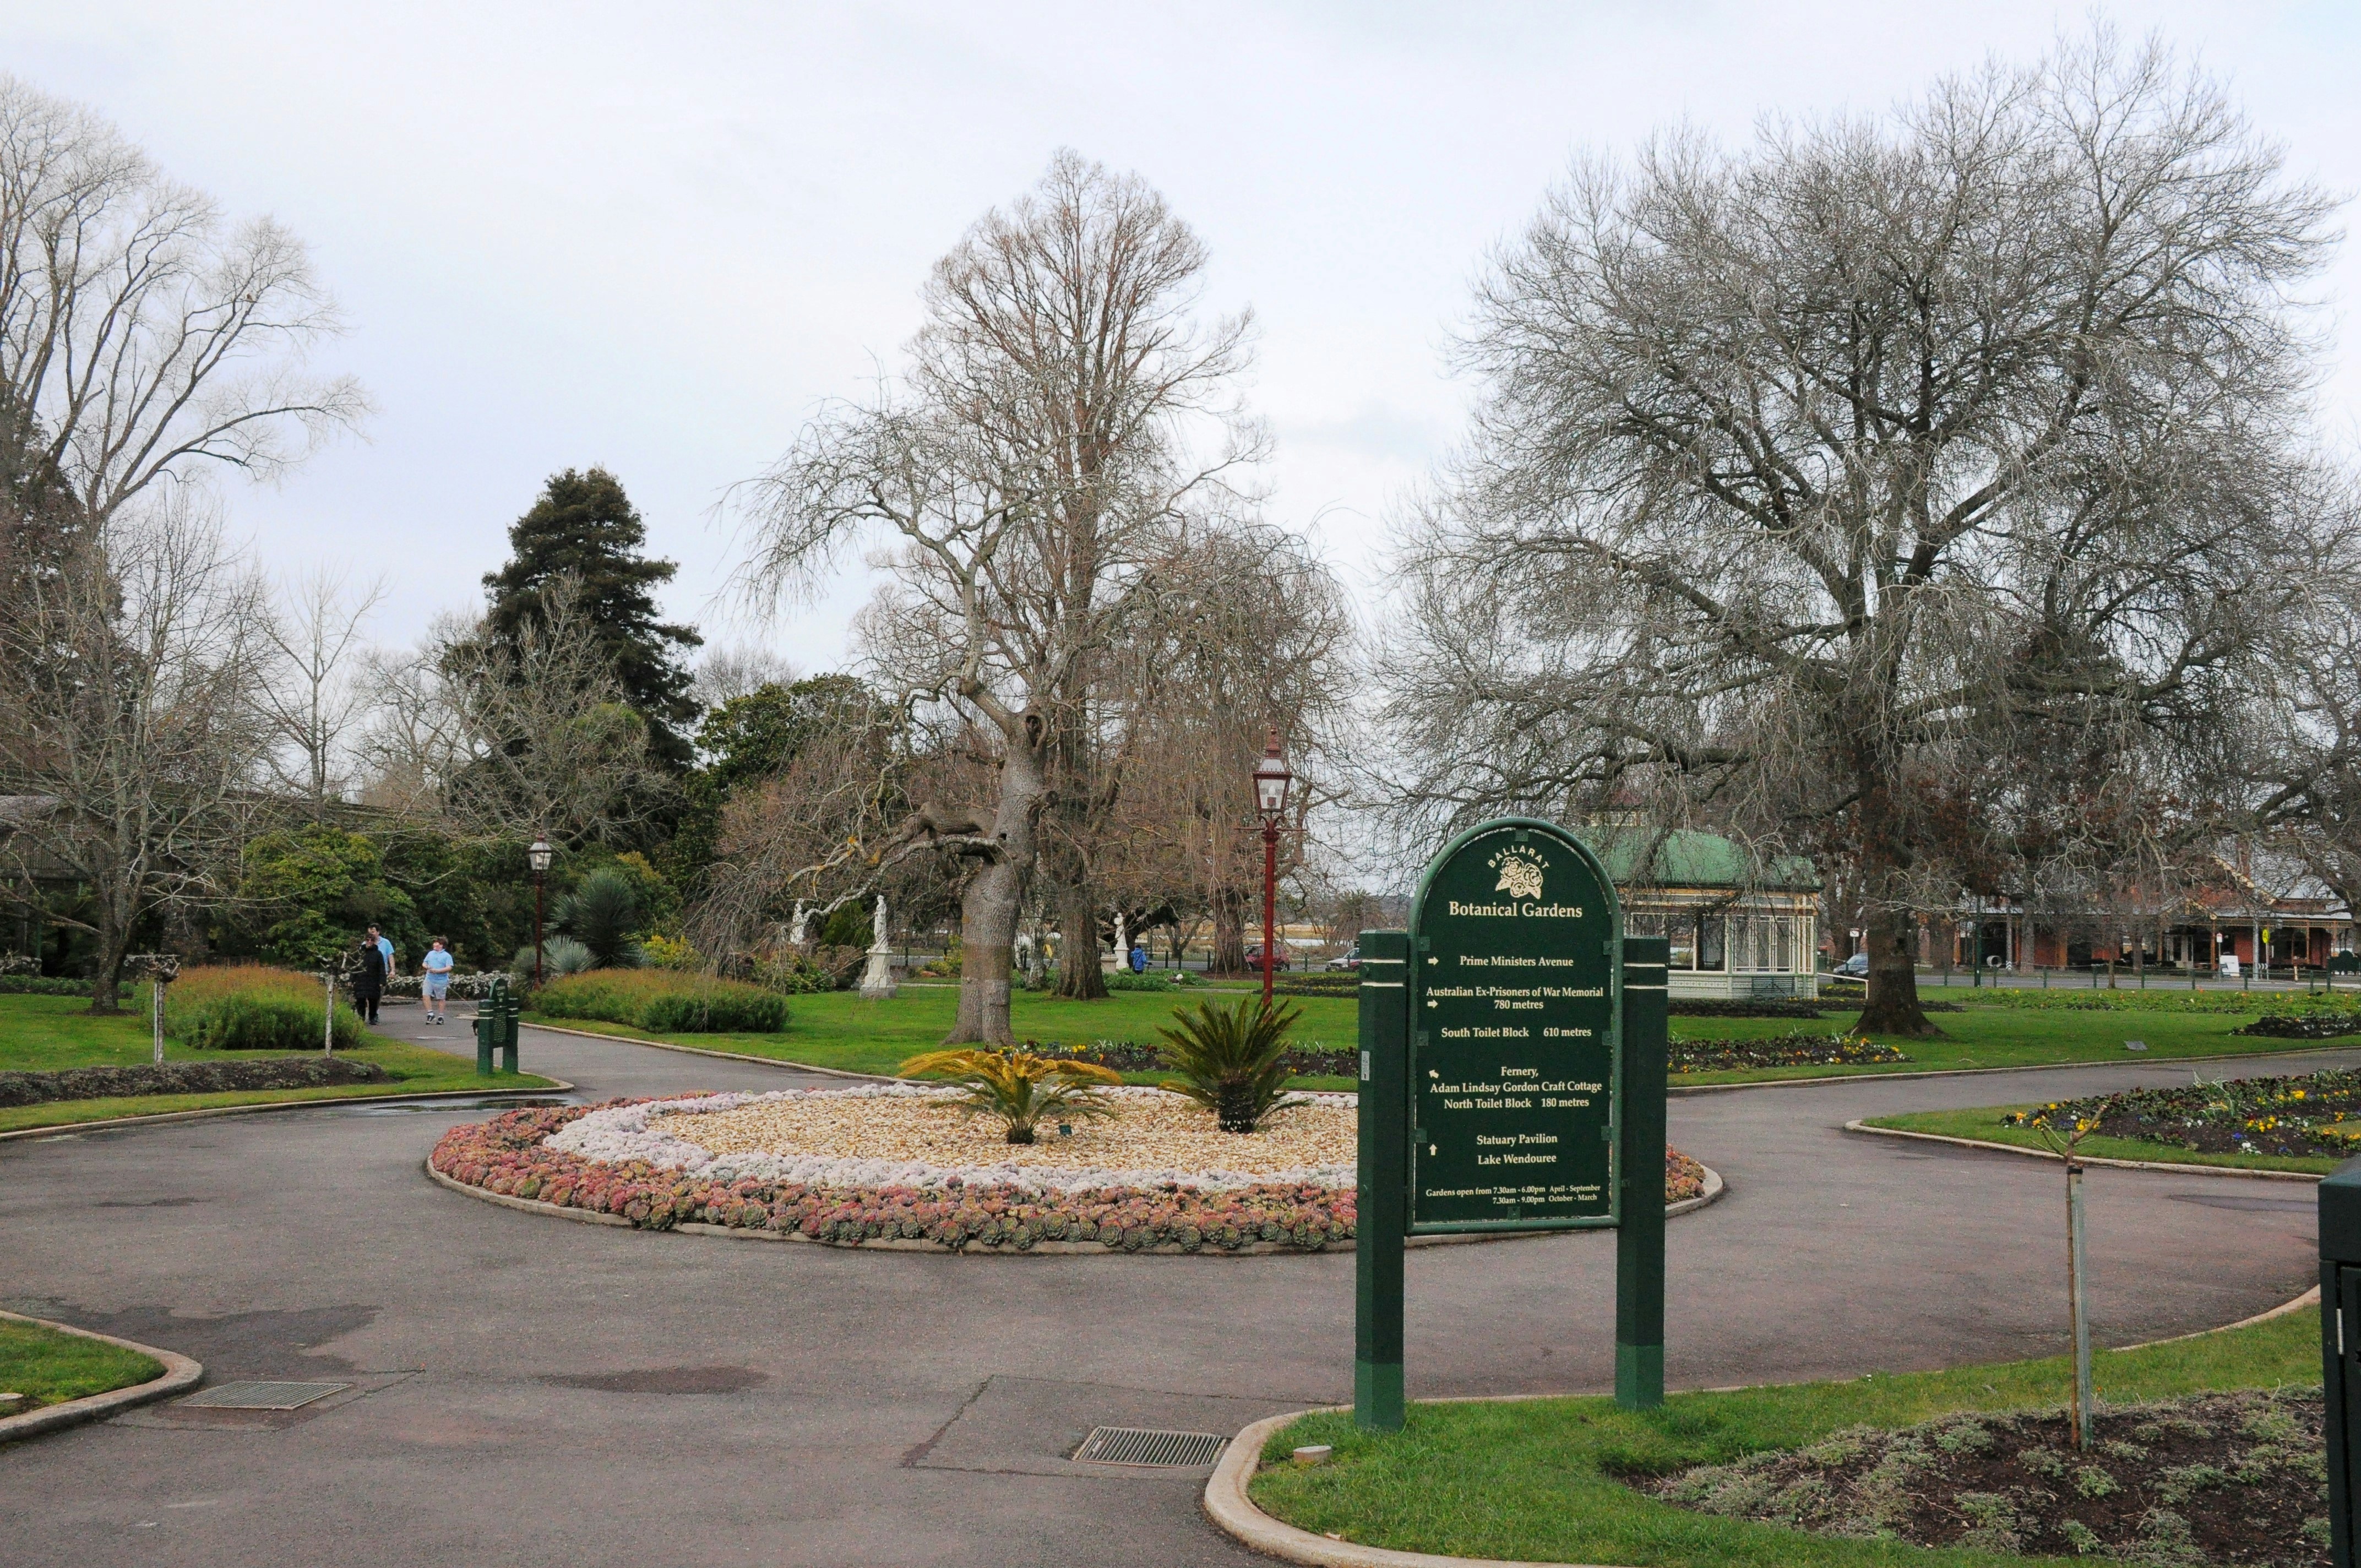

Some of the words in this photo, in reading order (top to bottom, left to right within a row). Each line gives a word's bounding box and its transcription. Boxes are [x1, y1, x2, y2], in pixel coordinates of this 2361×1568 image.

[1487, 845, 1551, 869] BALLARAT
[1449, 901, 1518, 917] Botanical
[1522, 902, 1582, 918] Gardens
[1460, 955, 1489, 966] Prime
[1491, 956, 1536, 966] Ministers
[1538, 956, 1574, 967] Avenue
[1426, 986, 1474, 997] Australian
[1475, 986, 1530, 997] Ex-Prisoners
[1531, 986, 1542, 997] of
[1543, 987, 1561, 997] War
[1562, 987, 1603, 997] Memorial
[1494, 999, 1510, 1009] 780
[1512, 1000, 1544, 1009] metres
[1441, 1027, 1471, 1038] South
[1472, 1027, 1500, 1037] Toilet
[1502, 1027, 1530, 1037] Block
[1543, 1027, 1559, 1037] 610
[1560, 1027, 1592, 1037] metres
[1500, 1066, 1539, 1079] Fernery,
[1430, 1082, 1460, 1093] Adam
[1462, 1082, 1501, 1095] Lindsay
[1503, 1081, 1539, 1092] Gordon
[1541, 1081, 1565, 1092] Craft
[1567, 1081, 1602, 1093] Cottage
[1444, 1098, 1473, 1109] North
[1475, 1098, 1503, 1109] Toilet
[1504, 1097, 1532, 1108] Block
[1541, 1097, 1557, 1107] 180
[1558, 1098, 1590, 1107] metres
[1477, 1135, 1517, 1147] Statuary
[1519, 1133, 1558, 1144] Pavilion
[1477, 1154, 1502, 1165] Lake
[1503, 1153, 1557, 1164] Wendouree
[1425, 1188, 1456, 1197] Gardens
[1456, 1189, 1474, 1198] open
[1475, 1187, 1492, 1195] from
[1492, 1186, 1516, 1195] 7.30am
[1521, 1185, 1546, 1195] 6.00pm
[1549, 1184, 1565, 1193] April
[1569, 1184, 1601, 1193] September
[1492, 1196, 1516, 1205] 7.30am
[1521, 1195, 1545, 1206] 9.00pm
[1548, 1194, 1574, 1202] October
[1577, 1193, 1598, 1201] March
